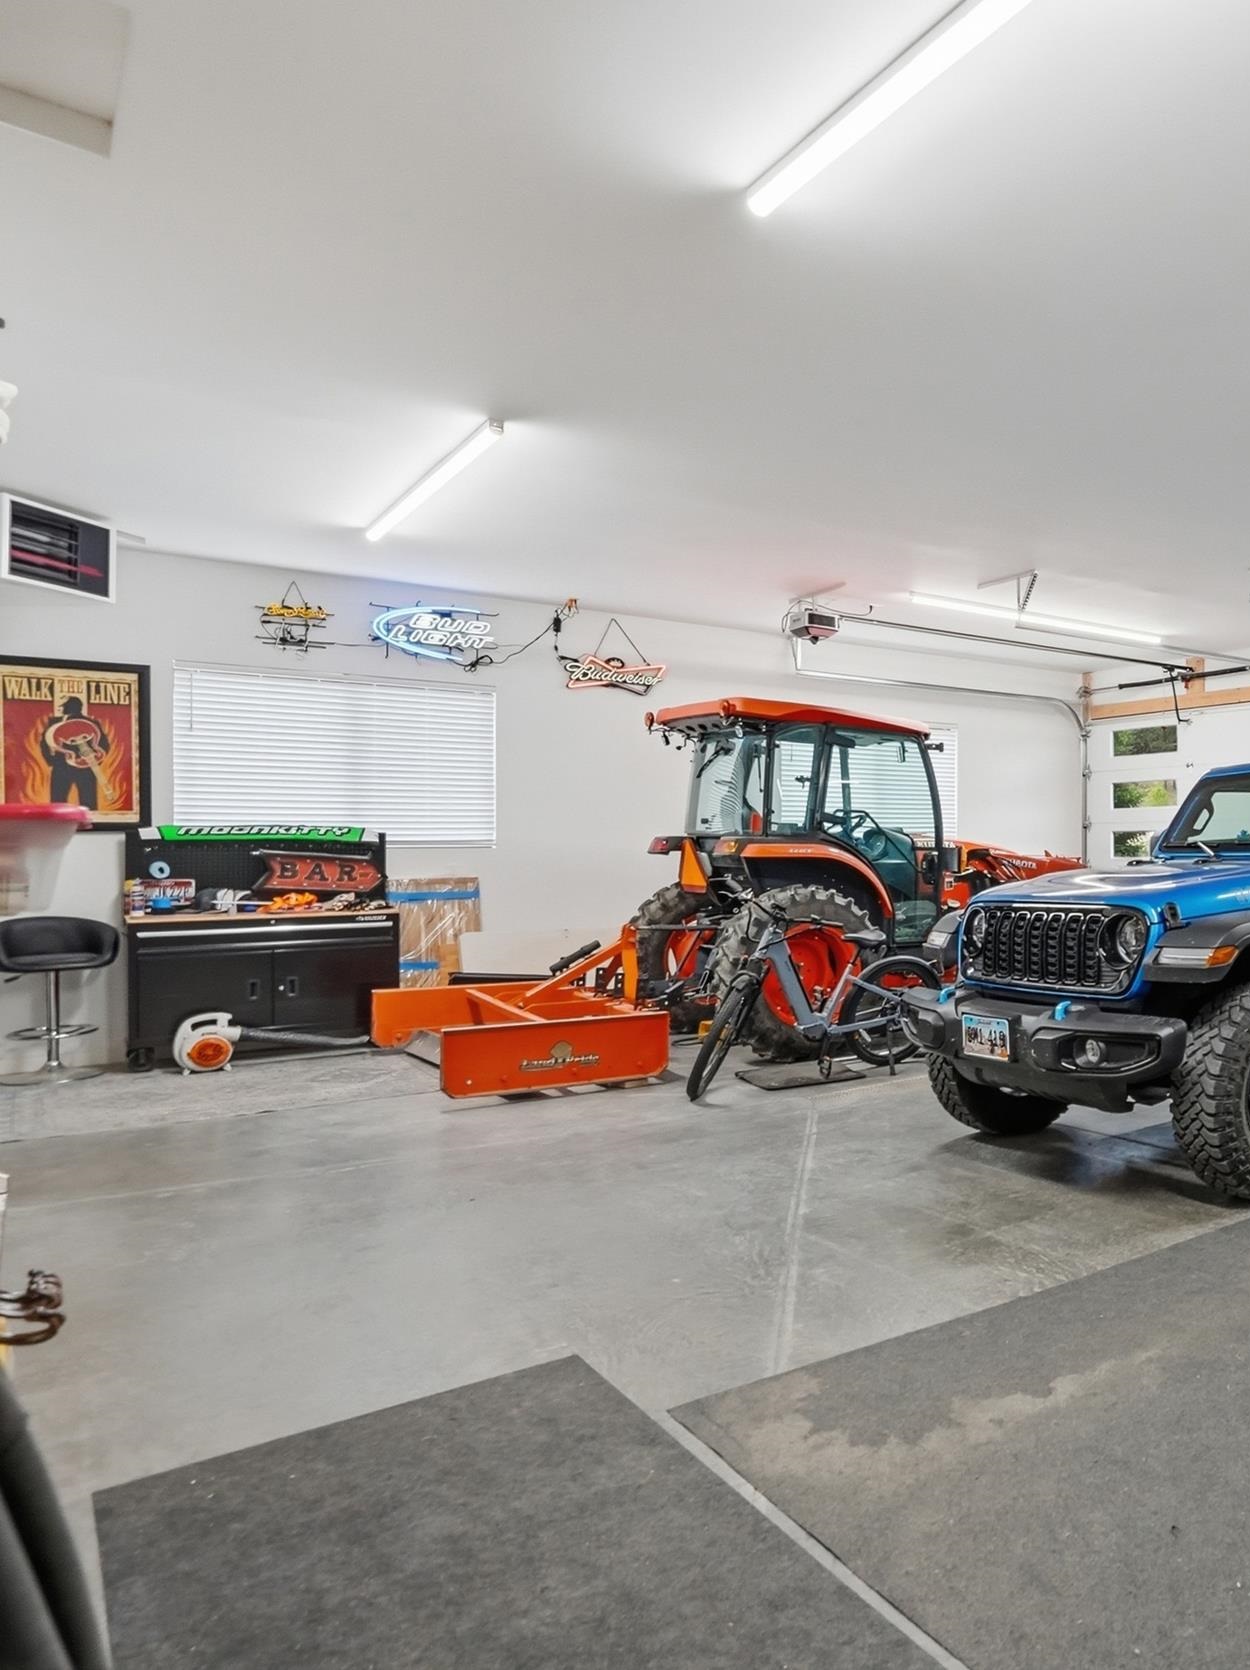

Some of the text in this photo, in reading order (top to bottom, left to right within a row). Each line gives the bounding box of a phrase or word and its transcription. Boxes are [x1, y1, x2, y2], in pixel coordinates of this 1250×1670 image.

[410, 613, 491, 634] BUD
[388, 625, 494, 648] LIGHT
[564, 662, 662, 686] Budweiser
[3, 676, 130, 705] WALK THE LINE
[277, 861, 359, 882] BAR
